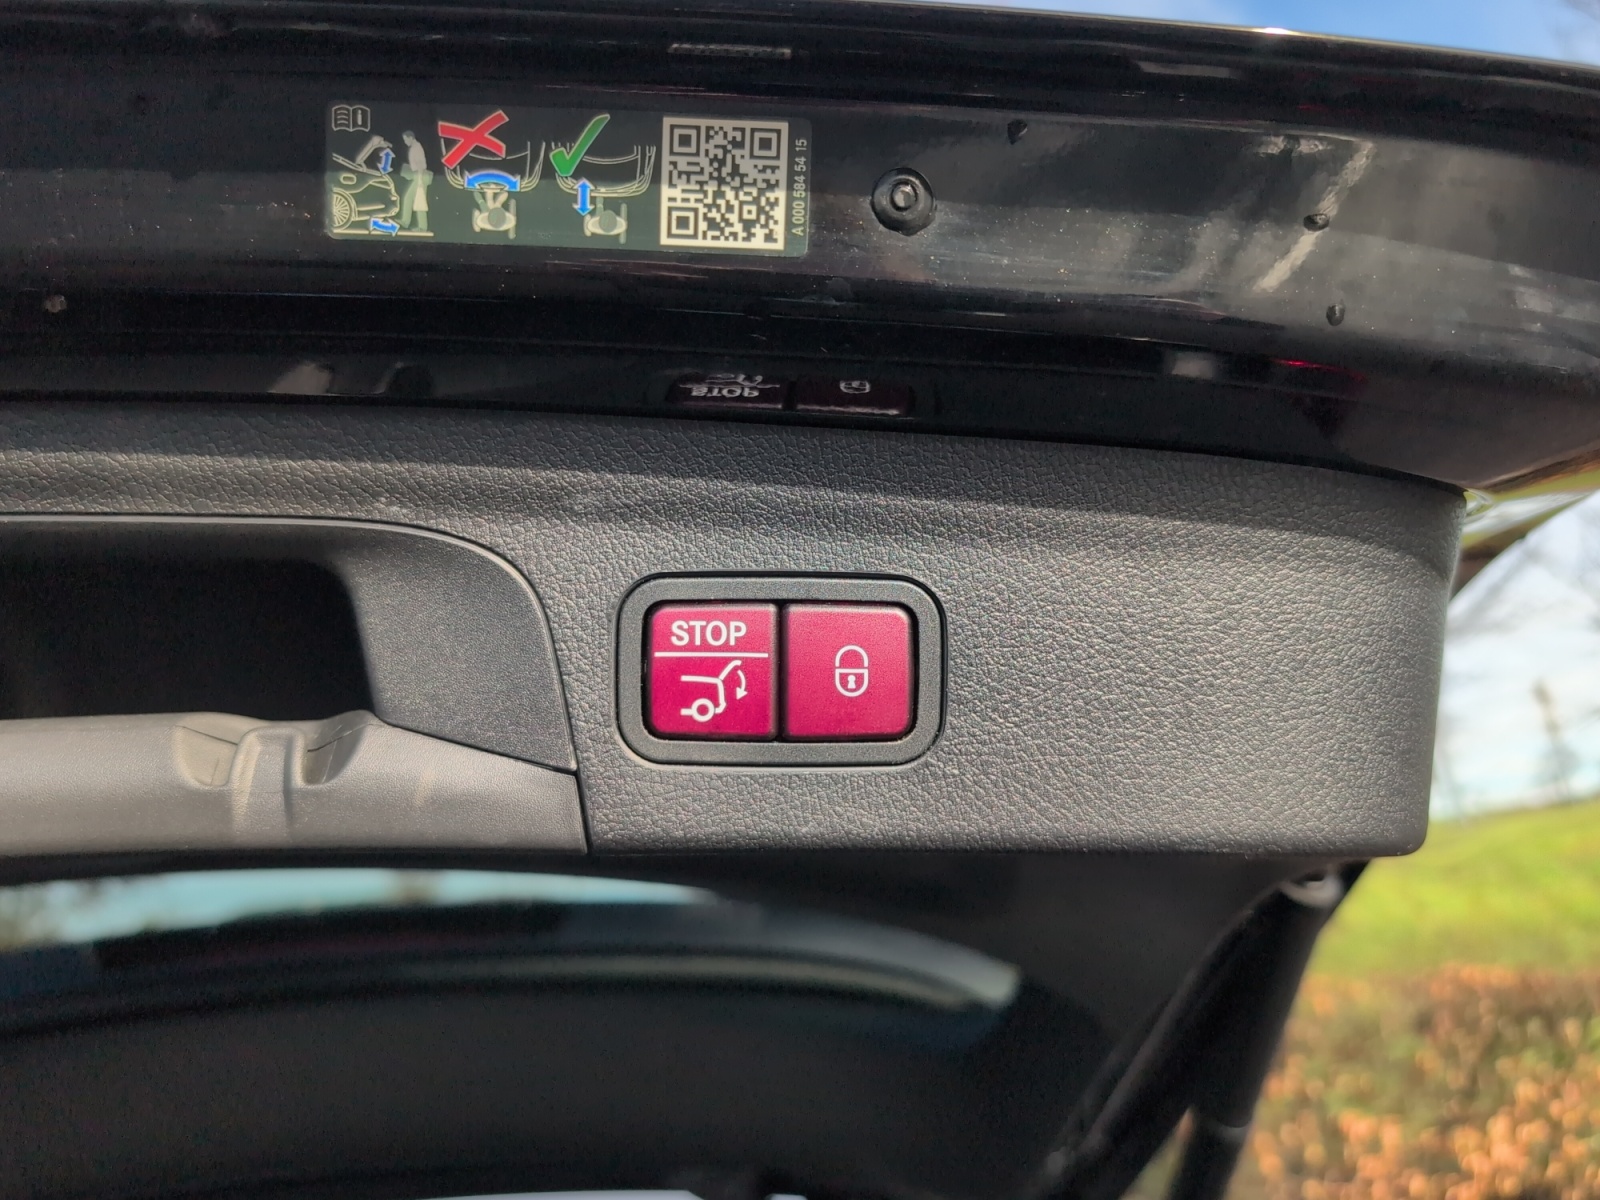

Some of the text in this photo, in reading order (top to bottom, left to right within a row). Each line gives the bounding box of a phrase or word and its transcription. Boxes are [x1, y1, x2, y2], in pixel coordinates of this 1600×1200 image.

[791, 138, 808, 237] A 000 584 54 15
[671, 620, 747, 646] STOP
